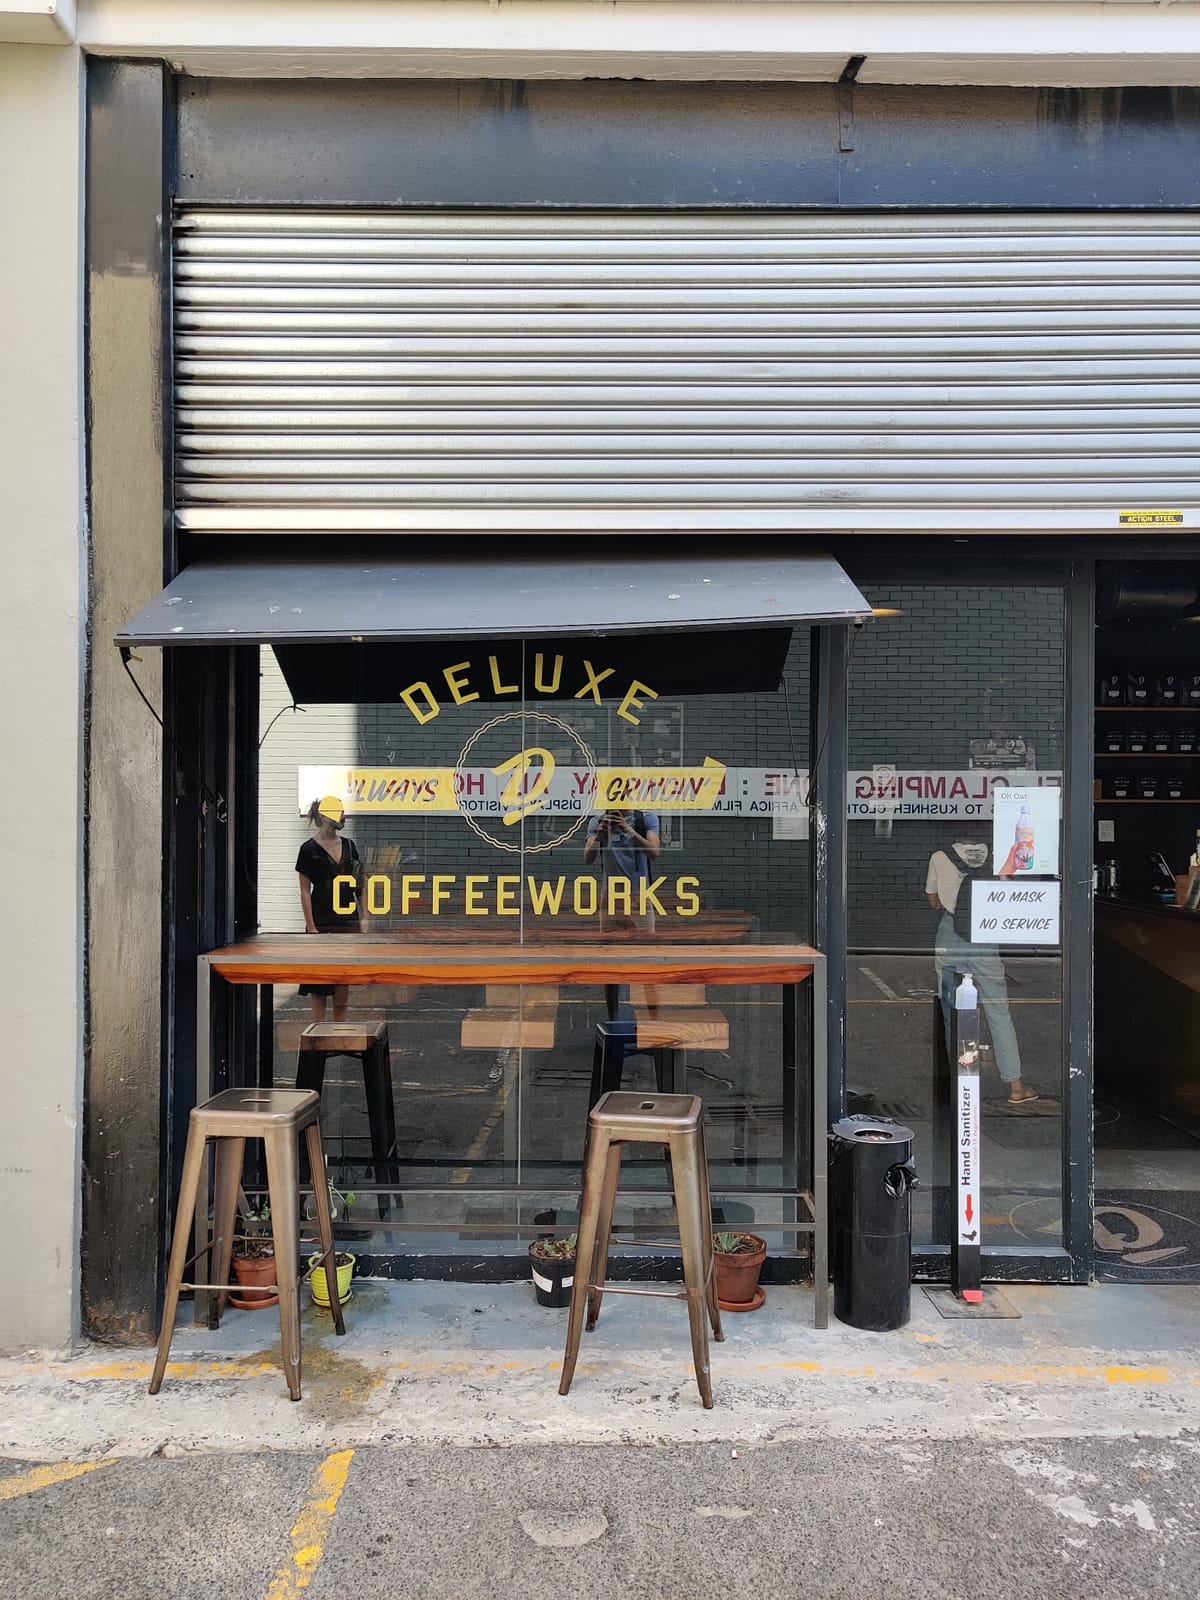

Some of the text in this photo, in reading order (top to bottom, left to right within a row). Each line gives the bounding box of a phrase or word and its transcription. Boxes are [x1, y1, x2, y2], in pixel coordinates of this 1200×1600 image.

[399, 653, 659, 726] DELUXE
[332, 875, 701, 917] COFFEEWORKS
[987, 890, 1047, 903] NO MASK
[979, 918, 1054, 930] NO SERVICE
[960, 1086, 971, 1186] Hand Sanitizer
